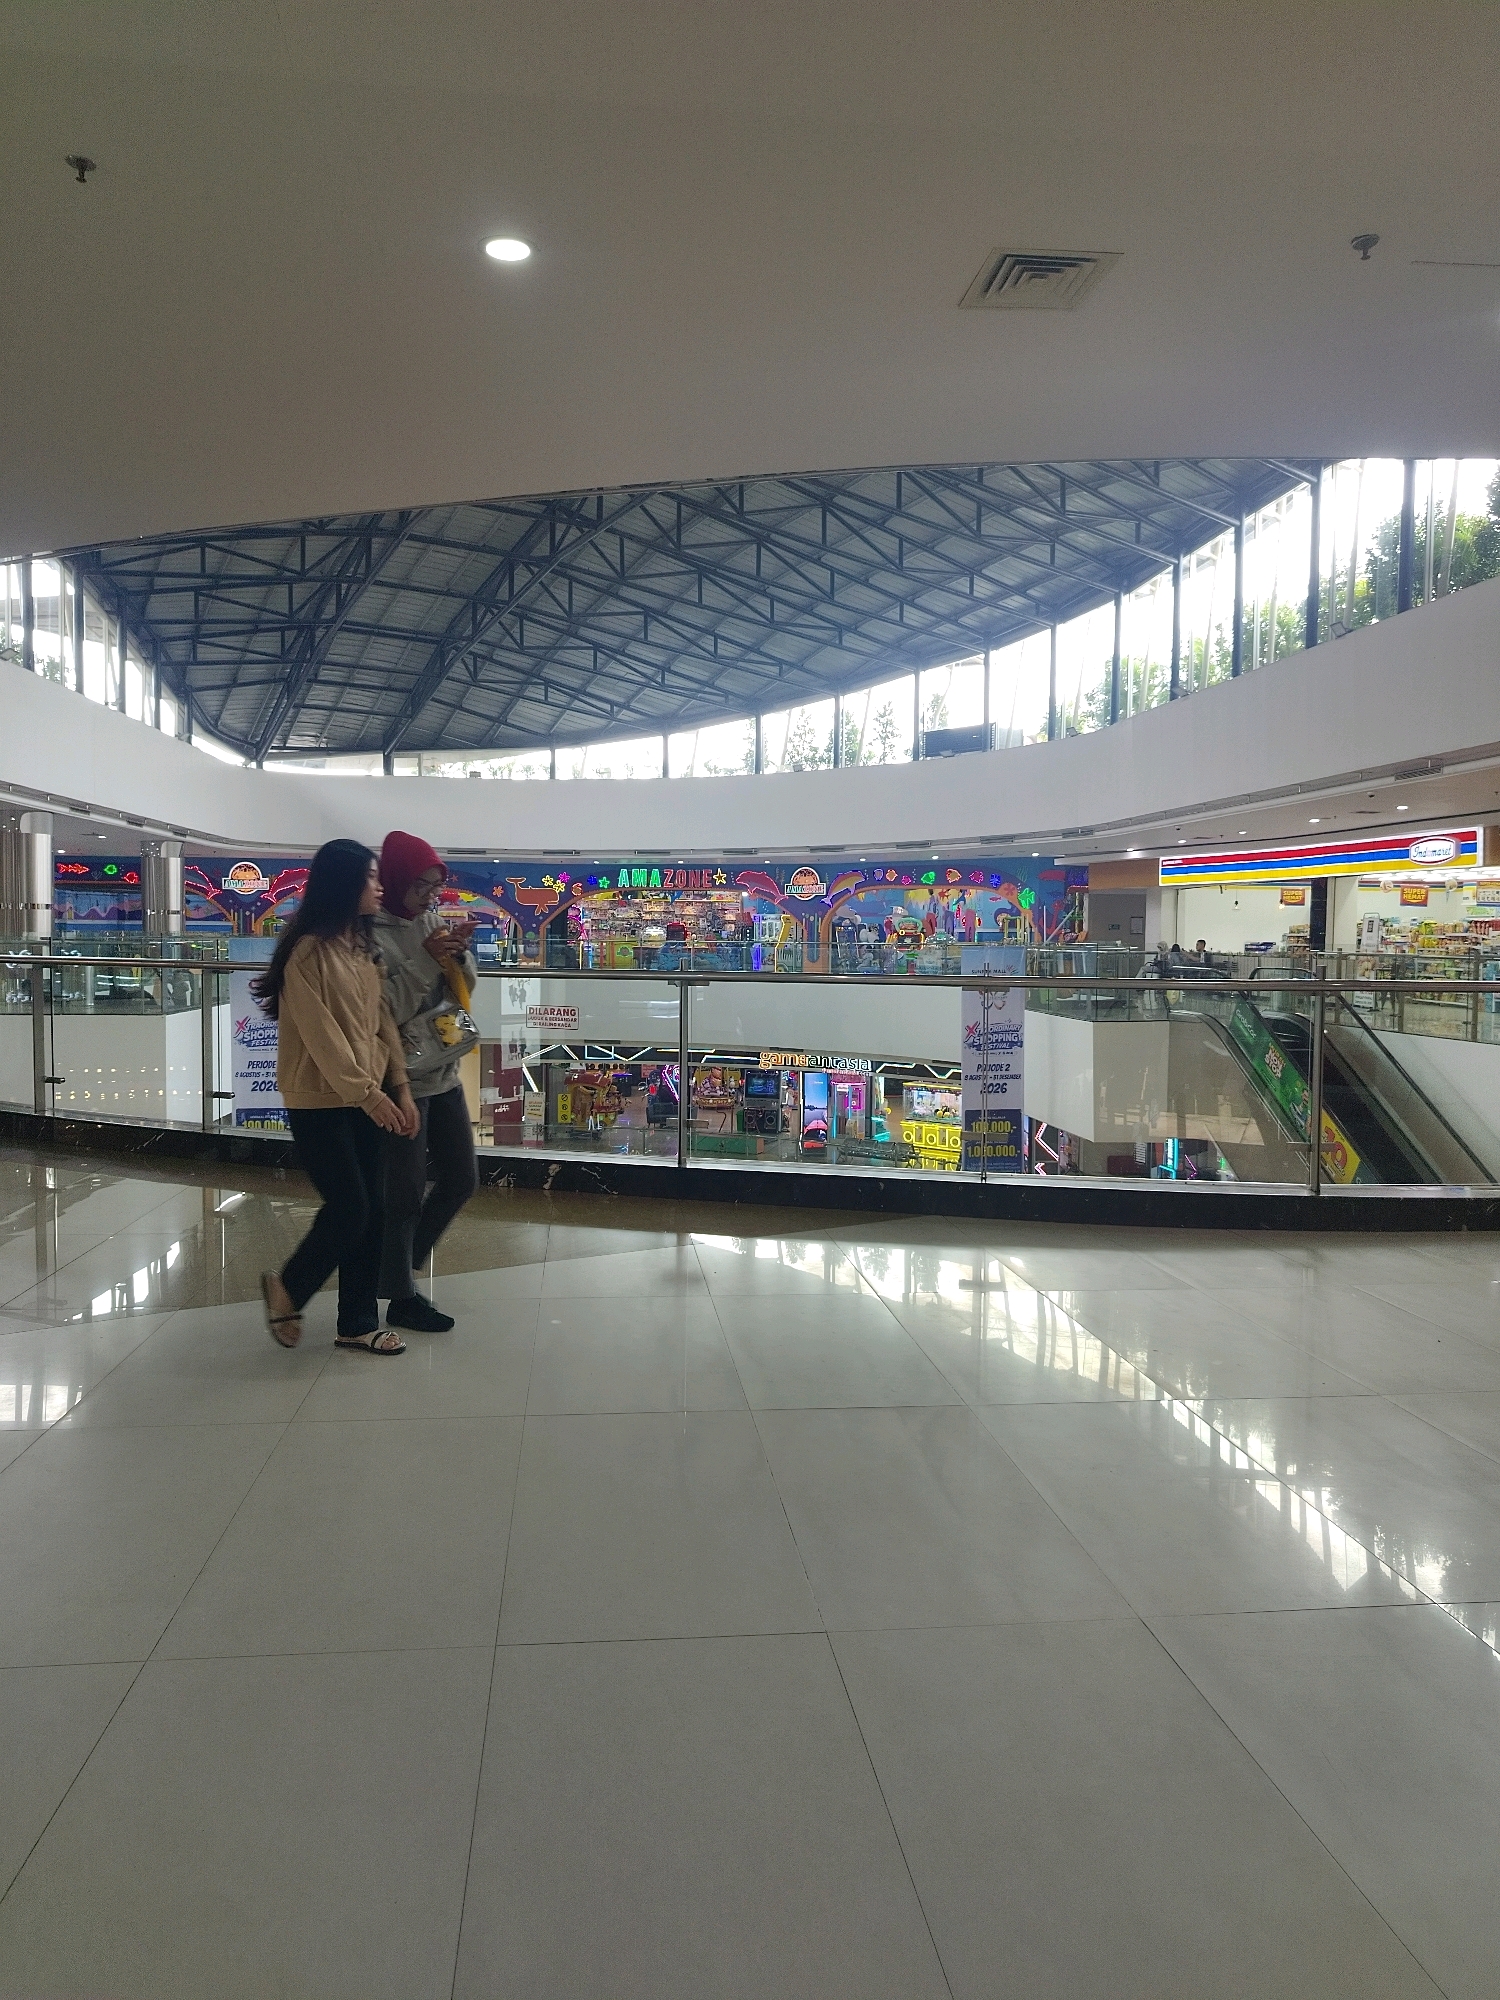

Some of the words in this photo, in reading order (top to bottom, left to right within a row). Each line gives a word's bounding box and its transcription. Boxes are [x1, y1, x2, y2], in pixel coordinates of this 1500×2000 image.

[1413, 844, 1452, 858] Indomaret
[618, 868, 713, 888] AMAZONE
[529, 1007, 577, 1016] DILARANG
[247, 1060, 277, 1070] PERIODE
[1004, 1063, 1011, 1071] 2
